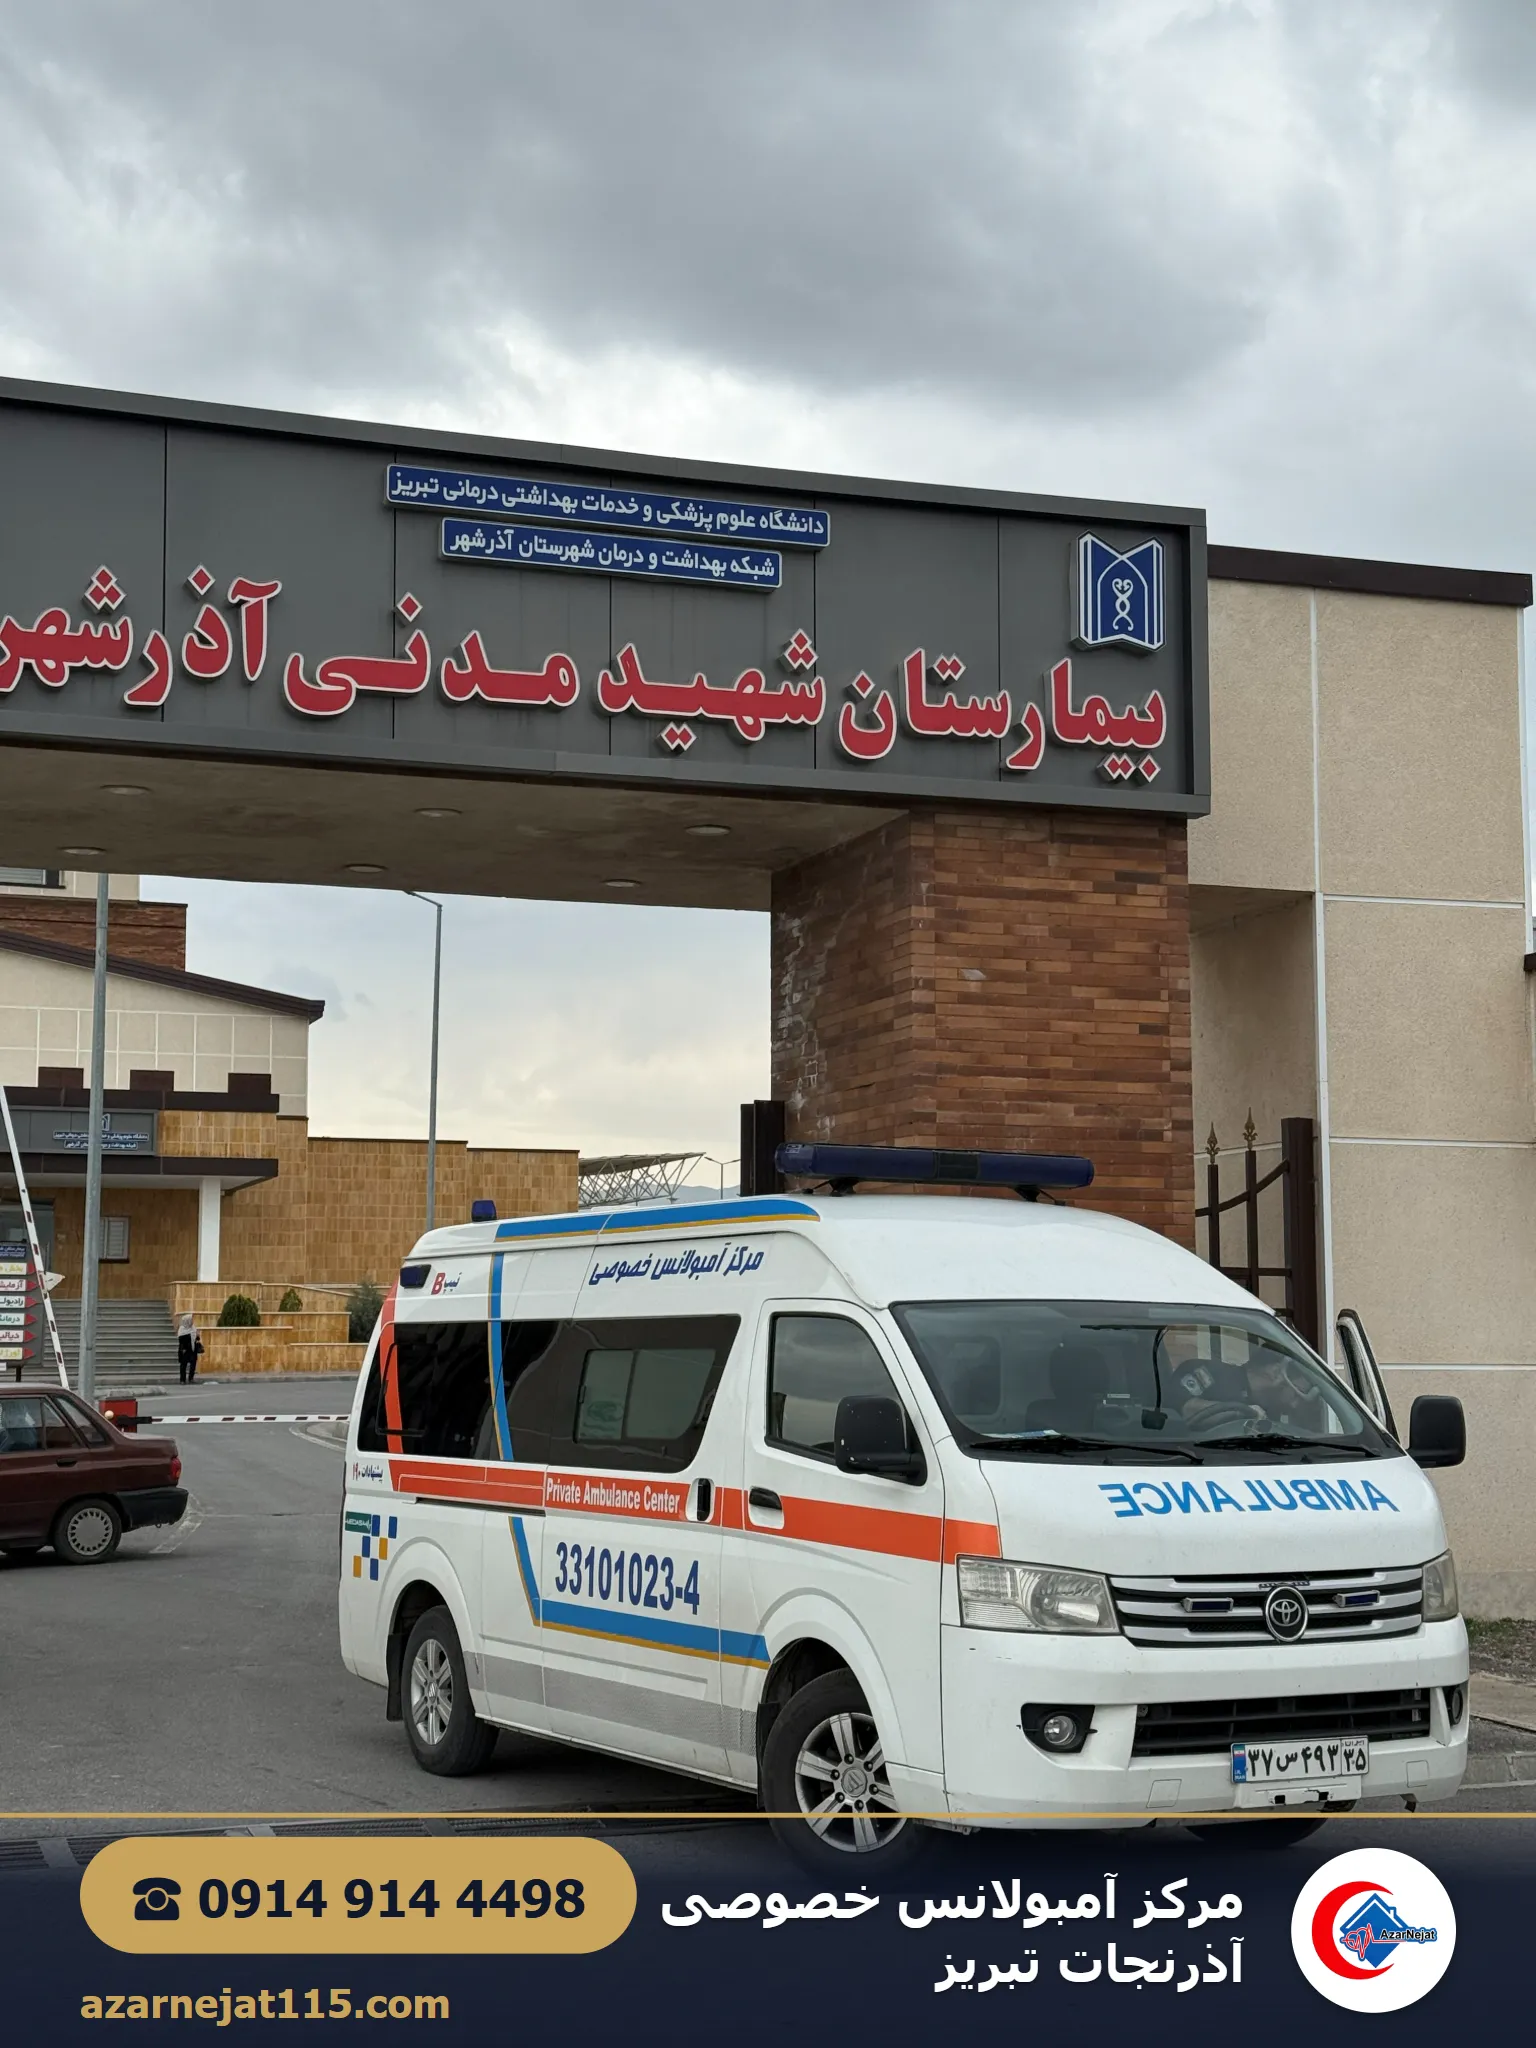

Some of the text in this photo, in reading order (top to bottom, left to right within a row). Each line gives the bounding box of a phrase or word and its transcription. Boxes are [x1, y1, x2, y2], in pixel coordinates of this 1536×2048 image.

[391, 472, 824, 534] دانشگاه علوم پزشکی و خدمات بهداشتی درمانی تبریز
[450, 528, 775, 581] شبکه بهداشت و درمان شهرستان آذرشهر
[283, 591, 582, 717] مدنی
[597, 627, 826, 753] شهید
[838, 647, 1167, 784] بیمارستان
[431, 1272, 446, 1295] B
[588, 1242, 765, 1286] مرکز آمبولانس خصوصی
[546, 1478, 681, 1514] Private Ambulance Center
[555, 1541, 700, 1615] 33101023-4
